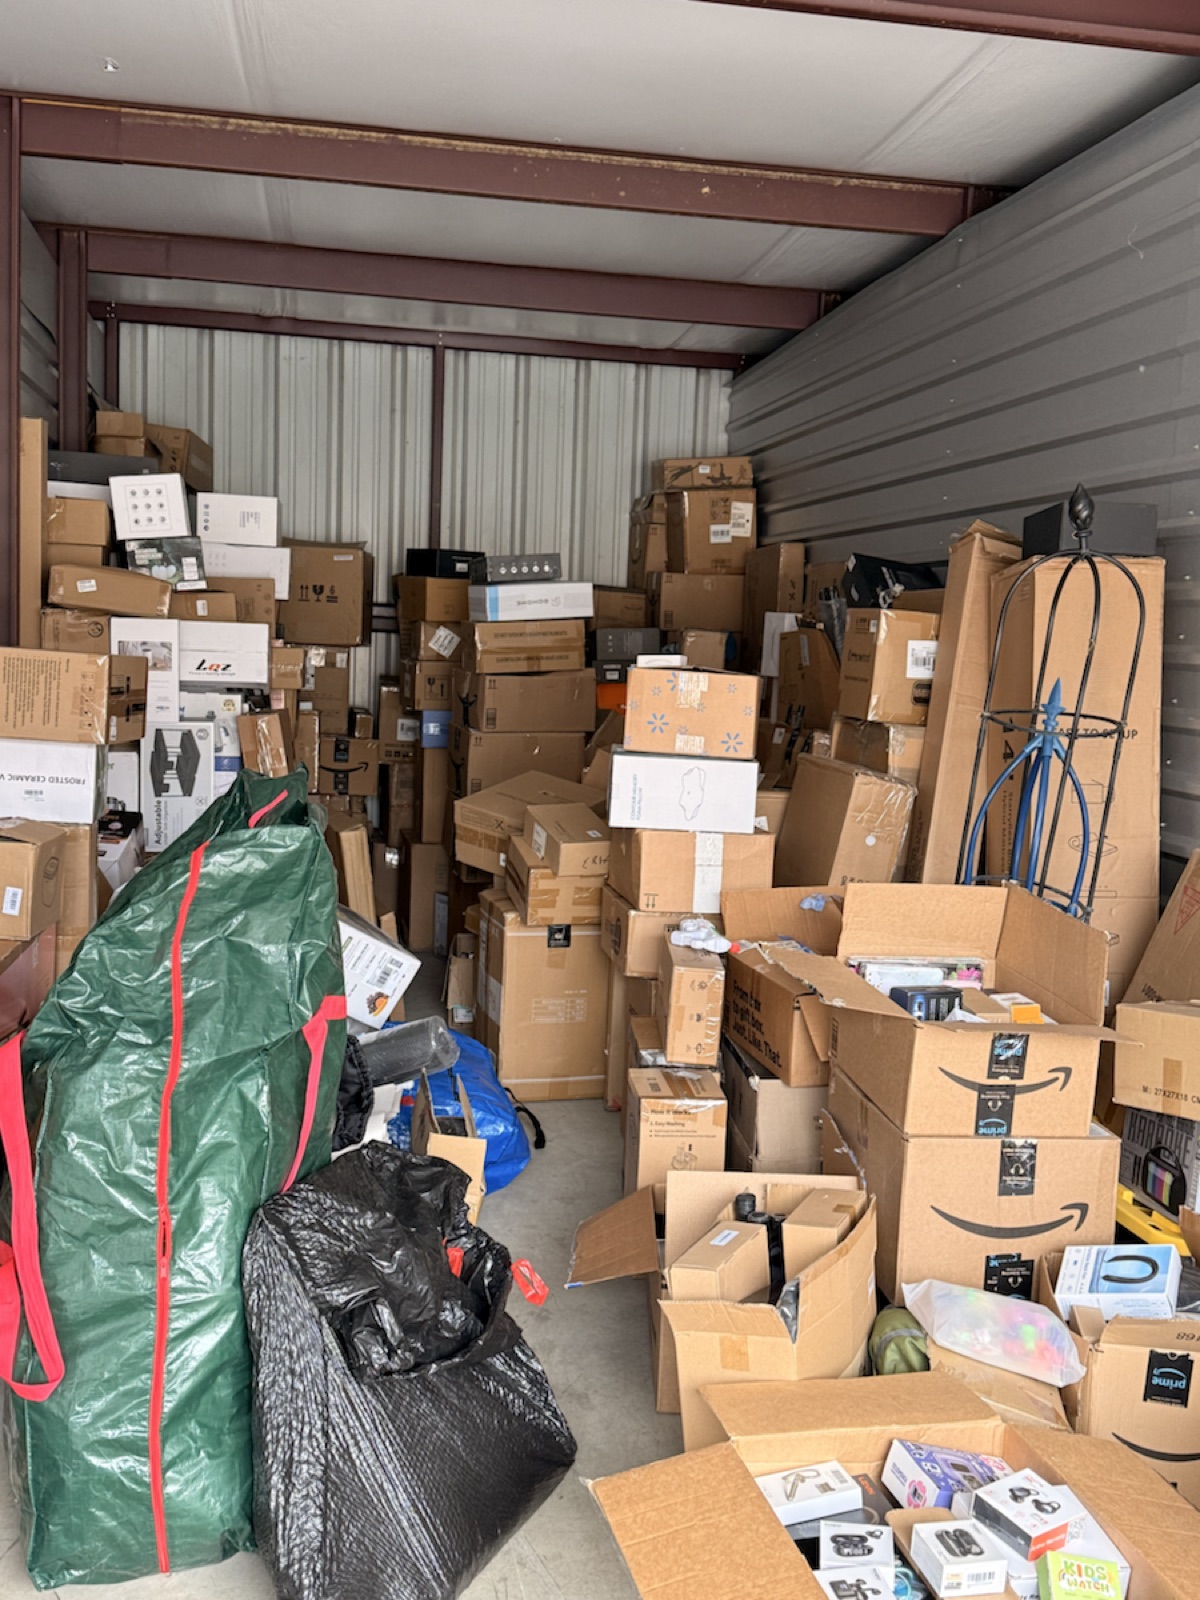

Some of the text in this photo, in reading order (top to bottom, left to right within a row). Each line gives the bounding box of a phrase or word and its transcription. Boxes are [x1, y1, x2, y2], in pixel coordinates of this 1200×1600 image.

[7, 773, 46, 784] CERAMIC
[48, 775, 86, 786] FROSTED
[153, 799, 163, 845] Adjustable
[733, 1018, 782, 1068] Just. Like. That.
[978, 1123, 1008, 1137] prime
[1151, 1375, 1187, 1390] prime
[1063, 1559, 1108, 1580] KIDS
[1067, 1576, 1110, 1593] WATCH
